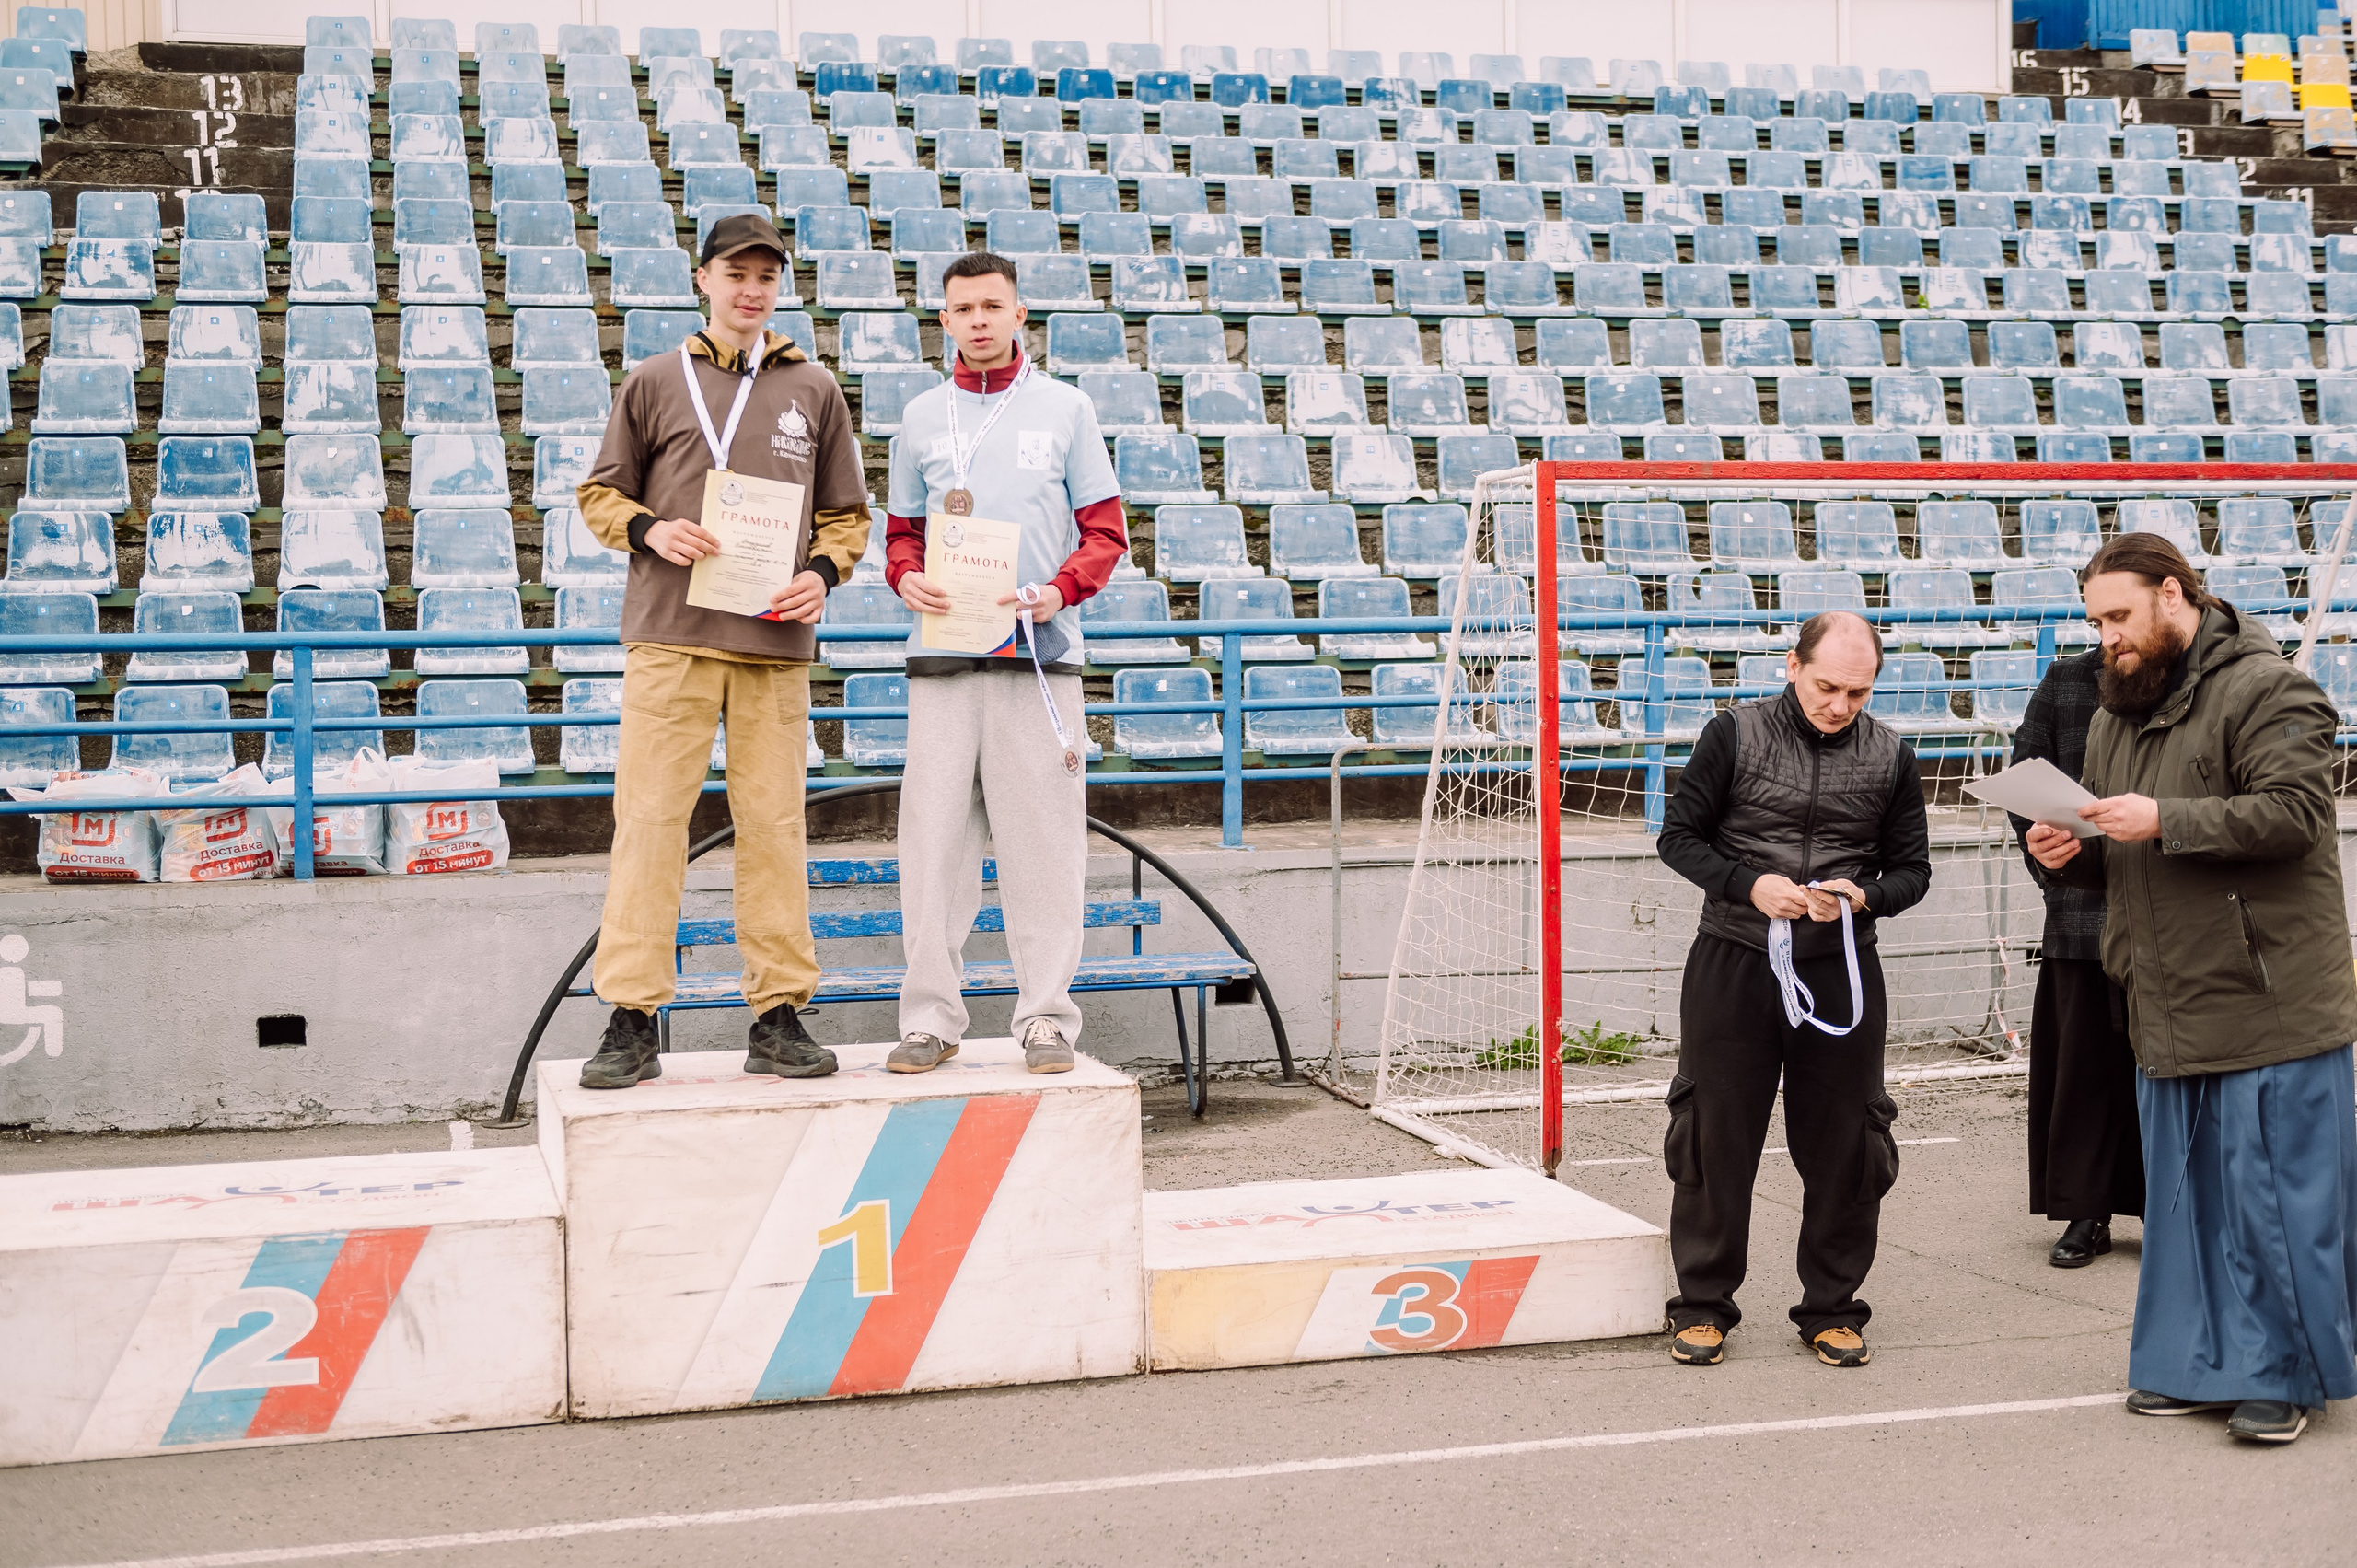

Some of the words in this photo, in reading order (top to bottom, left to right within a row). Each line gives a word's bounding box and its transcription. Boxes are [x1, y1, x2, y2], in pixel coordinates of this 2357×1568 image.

[2010, 49, 2038, 68] 16
[2058, 66, 2090, 96] 15
[200, 75, 243, 110] 13
[192, 110, 238, 147] 12
[184, 146, 220, 185] 11
[720, 511, 790, 531] ГРАМОТА
[944, 552, 1009, 570] ГРАМОТА
[59, 852, 126, 865] Доставка
[200, 842, 263, 861] Доставка
[418, 842, 481, 858] Доставка
[198, 867, 214, 877] от
[216, 862, 232, 874] 15
[233, 855, 270, 872] минут
[415, 864, 430, 874] от
[434, 860, 447, 870] 15
[449, 854, 487, 868] минут
[1401, 1211, 1515, 1222] СТАДИОН
[818, 1199, 893, 1297] 1
[1368, 1265, 1467, 1352] 3
[192, 1286, 320, 1393] 2
